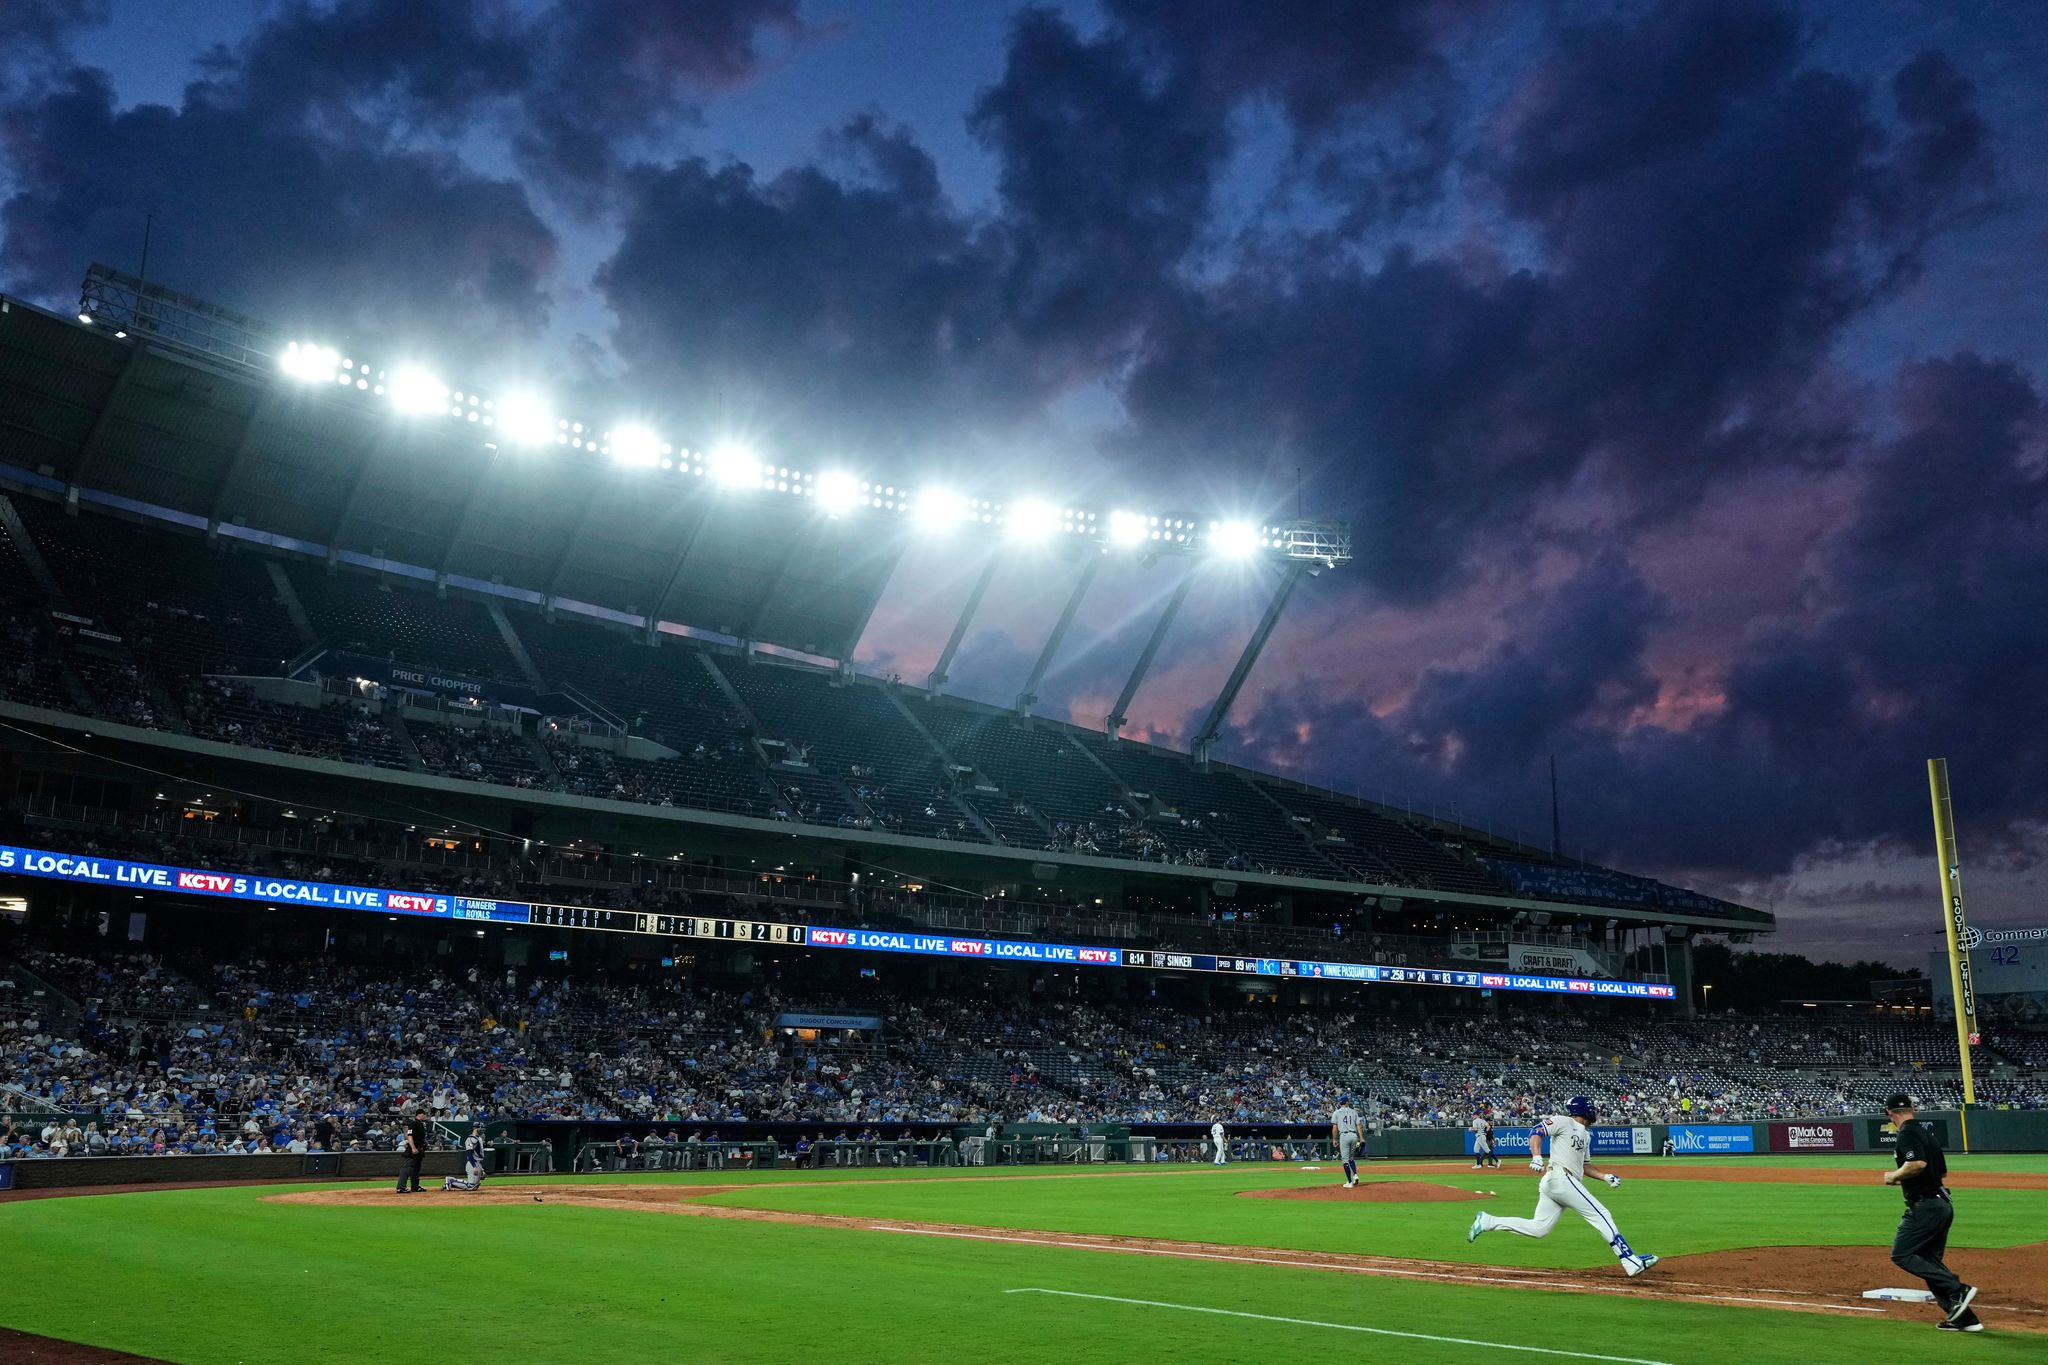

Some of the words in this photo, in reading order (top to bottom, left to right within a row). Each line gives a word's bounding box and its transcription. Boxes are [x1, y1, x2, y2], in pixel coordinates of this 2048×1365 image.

[392, 669, 424, 683] PRICE
[431, 677, 481, 694] CHOPPER
[0, 851, 15, 867] 5
[24, 854, 110, 879] LOCAL.
[116, 865, 172, 886] LIVE.
[179, 872, 231, 891] KCTV
[233, 879, 247, 893] 5
[254, 880, 328, 902] LOCAL.
[333, 889, 382, 907] LIVE.
[387, 895, 433, 911] KCTV
[435, 899, 447, 912] 5
[466, 900, 497, 911] RANGERS
[466, 909, 490, 919] ROYALS
[1953, 897, 1962, 932] ROOT
[640, 919, 646, 928] R
[660, 920, 665, 930] H
[680, 922, 684, 932] E
[703, 921, 709, 934] B
[722, 923, 727, 936] 1
[740, 924, 746, 937] S
[757, 925, 765, 939] 2
[1984, 929, 2048, 941] Commer
[811, 930, 846, 944] KCTV
[847, 933, 856, 945] 5
[861, 934, 910, 949] LOCAL.
[914, 938, 948, 952] LIVE.
[952, 941, 982, 954] KCTV
[984, 943, 992, 954] 5
[996, 944, 1042, 958] LOCAL.
[1045, 948, 1076, 960] LIVE.
[1079, 949, 1108, 962] KCTV
[1109, 951, 1117, 962] 5
[1958, 942, 1966, 952] 4
[1129, 953, 1144, 964] 8:14
[1167, 955, 1192, 967] SINKER
[1991, 945, 2020, 966] 42
[1235, 960, 1244, 971] 89
[1245, 962, 1257, 971] MPH
[1523, 955, 1544, 967] CRAFT
[1546, 957, 1551, 967] &
[1552, 957, 1573, 969] DRAFT
[1302, 963, 1307, 974] 9
[1341, 965, 1377, 978] PASQUANTINO
[1390, 969, 1404, 981] .258
[1417, 971, 1425, 982] 24
[1442, 973, 1451, 984] 83
[1483, 976, 1504, 986] KCTV
[1504, 977, 1511, 987] 5
[1513, 977, 1544, 989] LOCAL.
[1546, 980, 1567, 990] LIVE.
[1569, 981, 1589, 991] KCTV
[1589, 982, 1595, 992] 5
[1597, 983, 1626, 994] LOCAL.
[1628, 985, 1648, 995] LIVE.
[1649, 986, 1667, 996] KCTV
[1667, 987, 1673, 996] 5
[1960, 962, 1973, 1015] CHIKIN
[826, 1018, 862, 1026] CONCOURSE
[13, 1118, 48, 1128] nityAmer
[1343, 1115, 1352, 1125] 41
[1798, 1126, 1816, 1137] Mark
[1817, 1126, 1833, 1137] One
[1494, 1132, 1529, 1147] nefitba
[1673, 1133, 1705, 1149] UMKC
